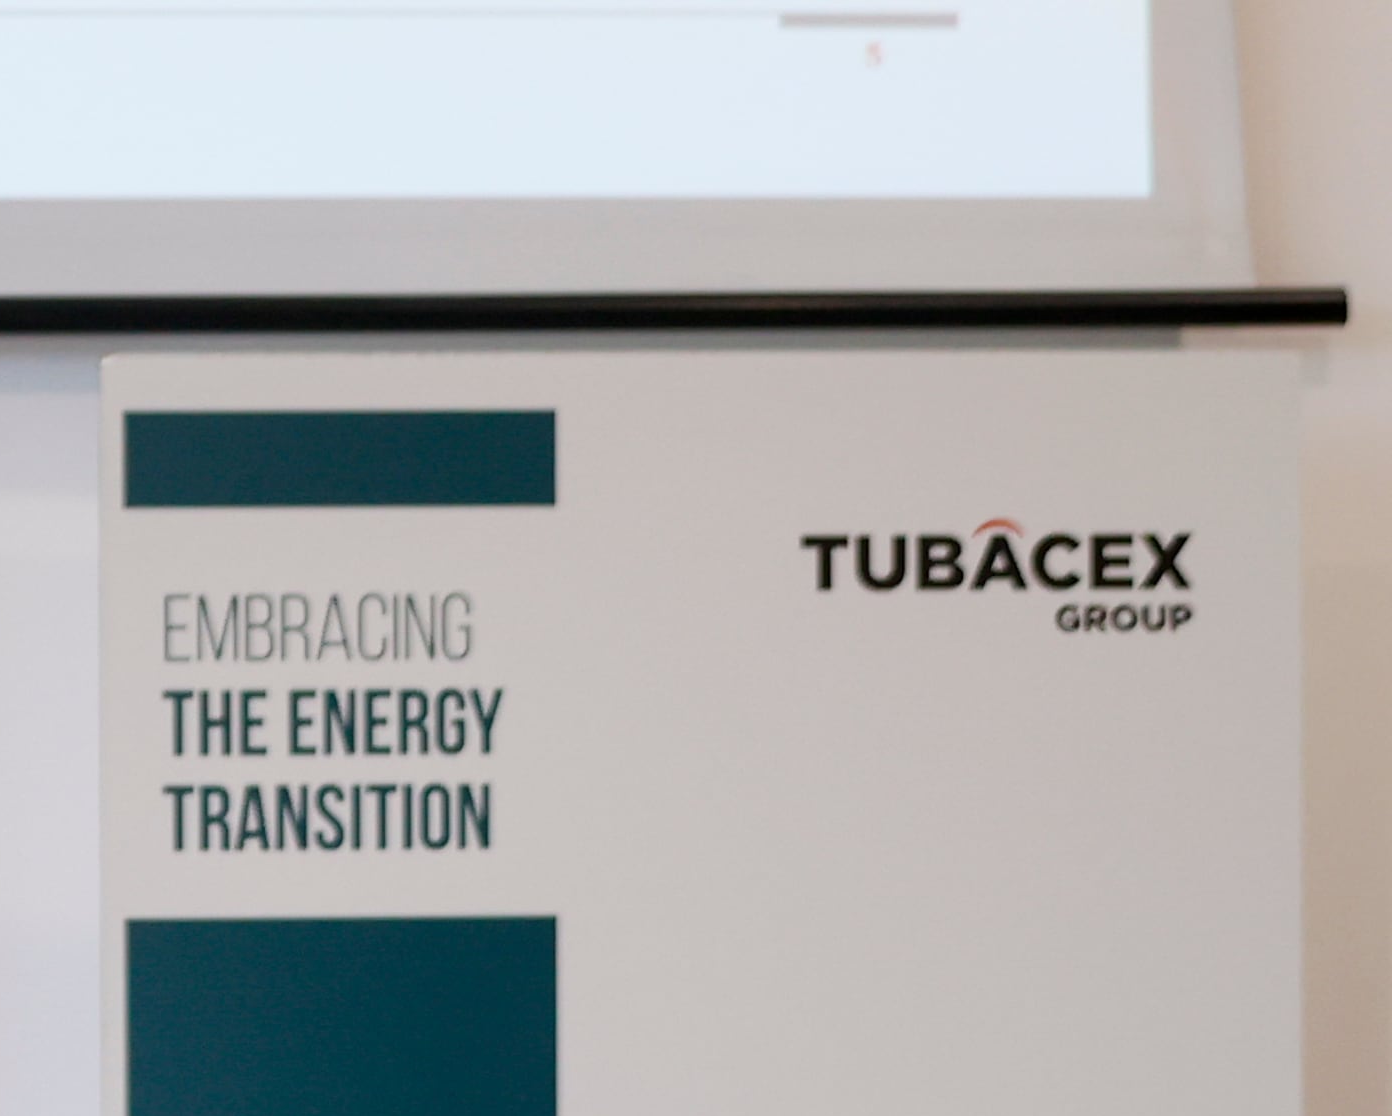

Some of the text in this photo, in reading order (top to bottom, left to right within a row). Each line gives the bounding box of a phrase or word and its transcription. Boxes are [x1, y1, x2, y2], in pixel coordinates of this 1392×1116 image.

[801, 532, 1192, 592] TUBACEX
[163, 592, 473, 663] EMBRACING
[1055, 604, 1194, 633] GROUP
[162, 687, 504, 757] THE ENERGY
[162, 783, 492, 852] TRANSITION
